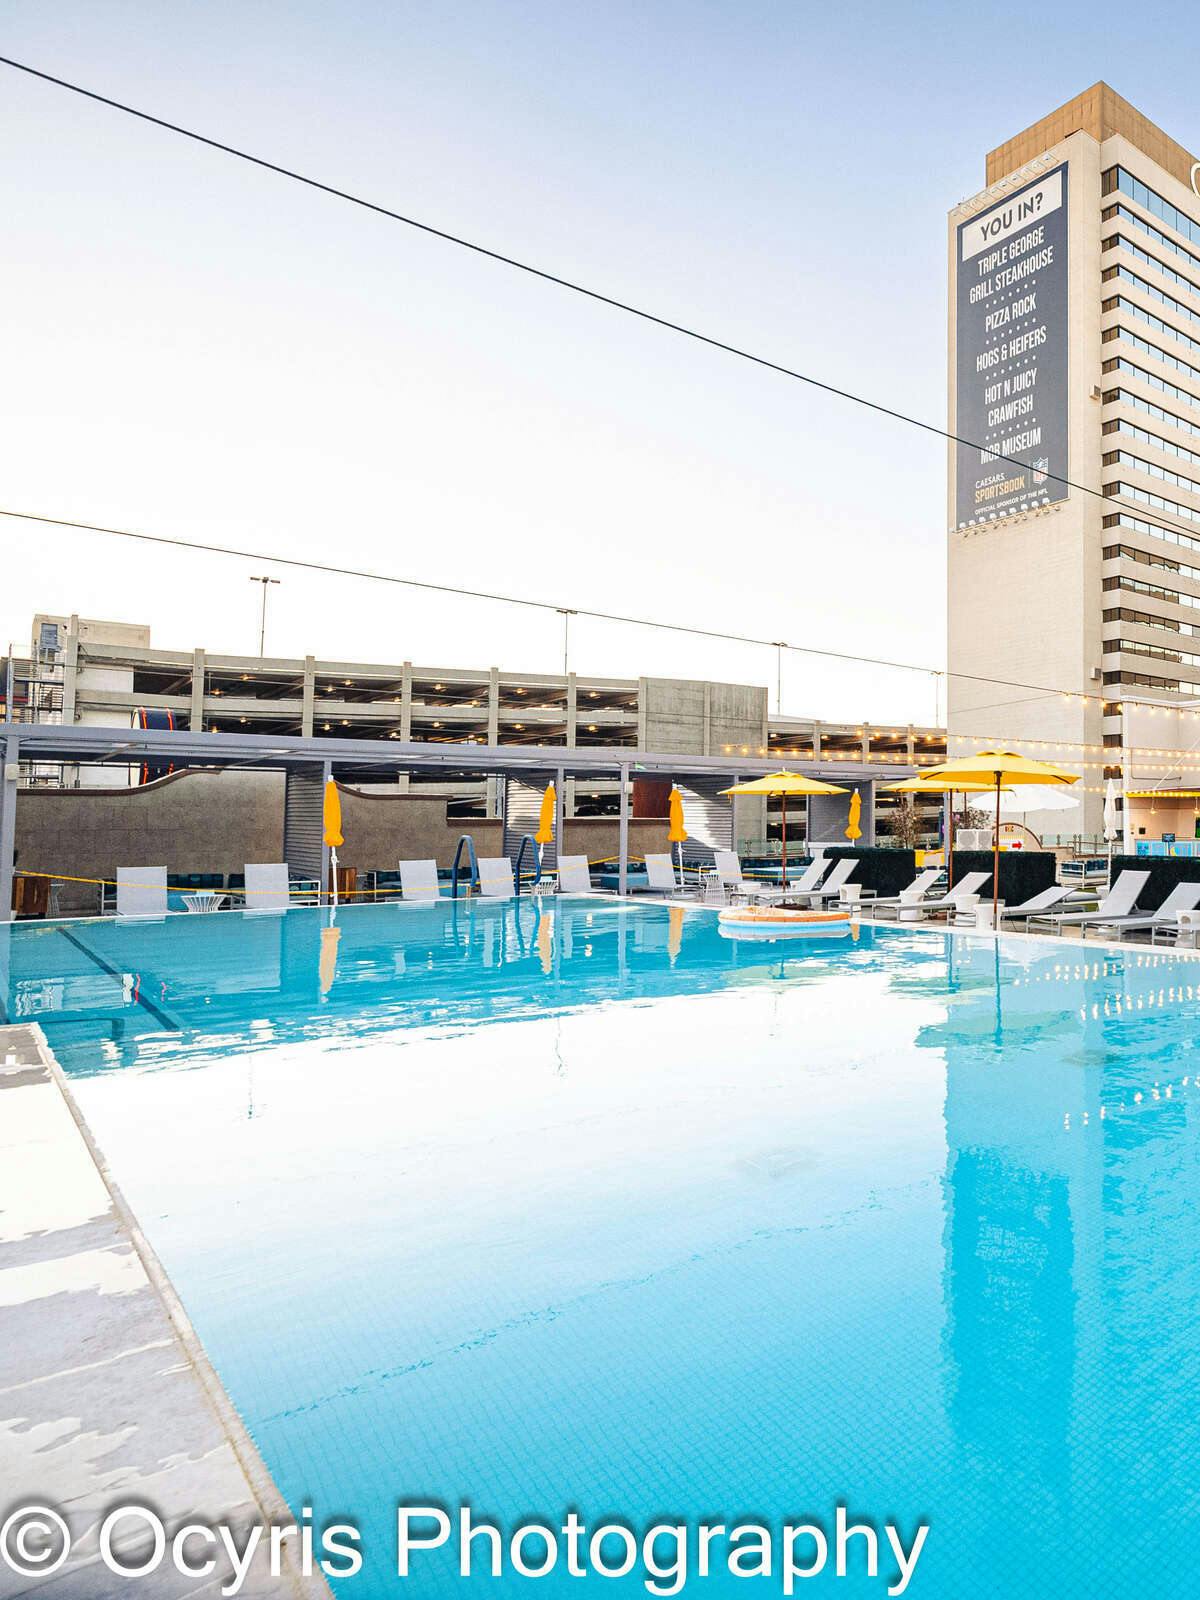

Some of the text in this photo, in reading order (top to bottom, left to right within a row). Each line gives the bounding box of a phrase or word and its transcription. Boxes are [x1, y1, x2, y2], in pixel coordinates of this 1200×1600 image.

[980, 192, 1044, 242] YOU IN?
[978, 226, 1045, 277] TRIPLE GEORGE
[969, 246, 1054, 304] GRILL STEAKHOUSE
[985, 293, 1037, 333] PIZZA ROCK
[976, 325, 1047, 373] HOGS & HEIFERS
[984, 368, 1038, 405] HOT N JUICY
[988, 394, 1034, 427] CRAWFISH
[980, 427, 1041, 465] MOB MUSEUM
[975, 472, 1005, 489] CAESARS
[975, 475, 1025, 503] SPORTSBOOK
